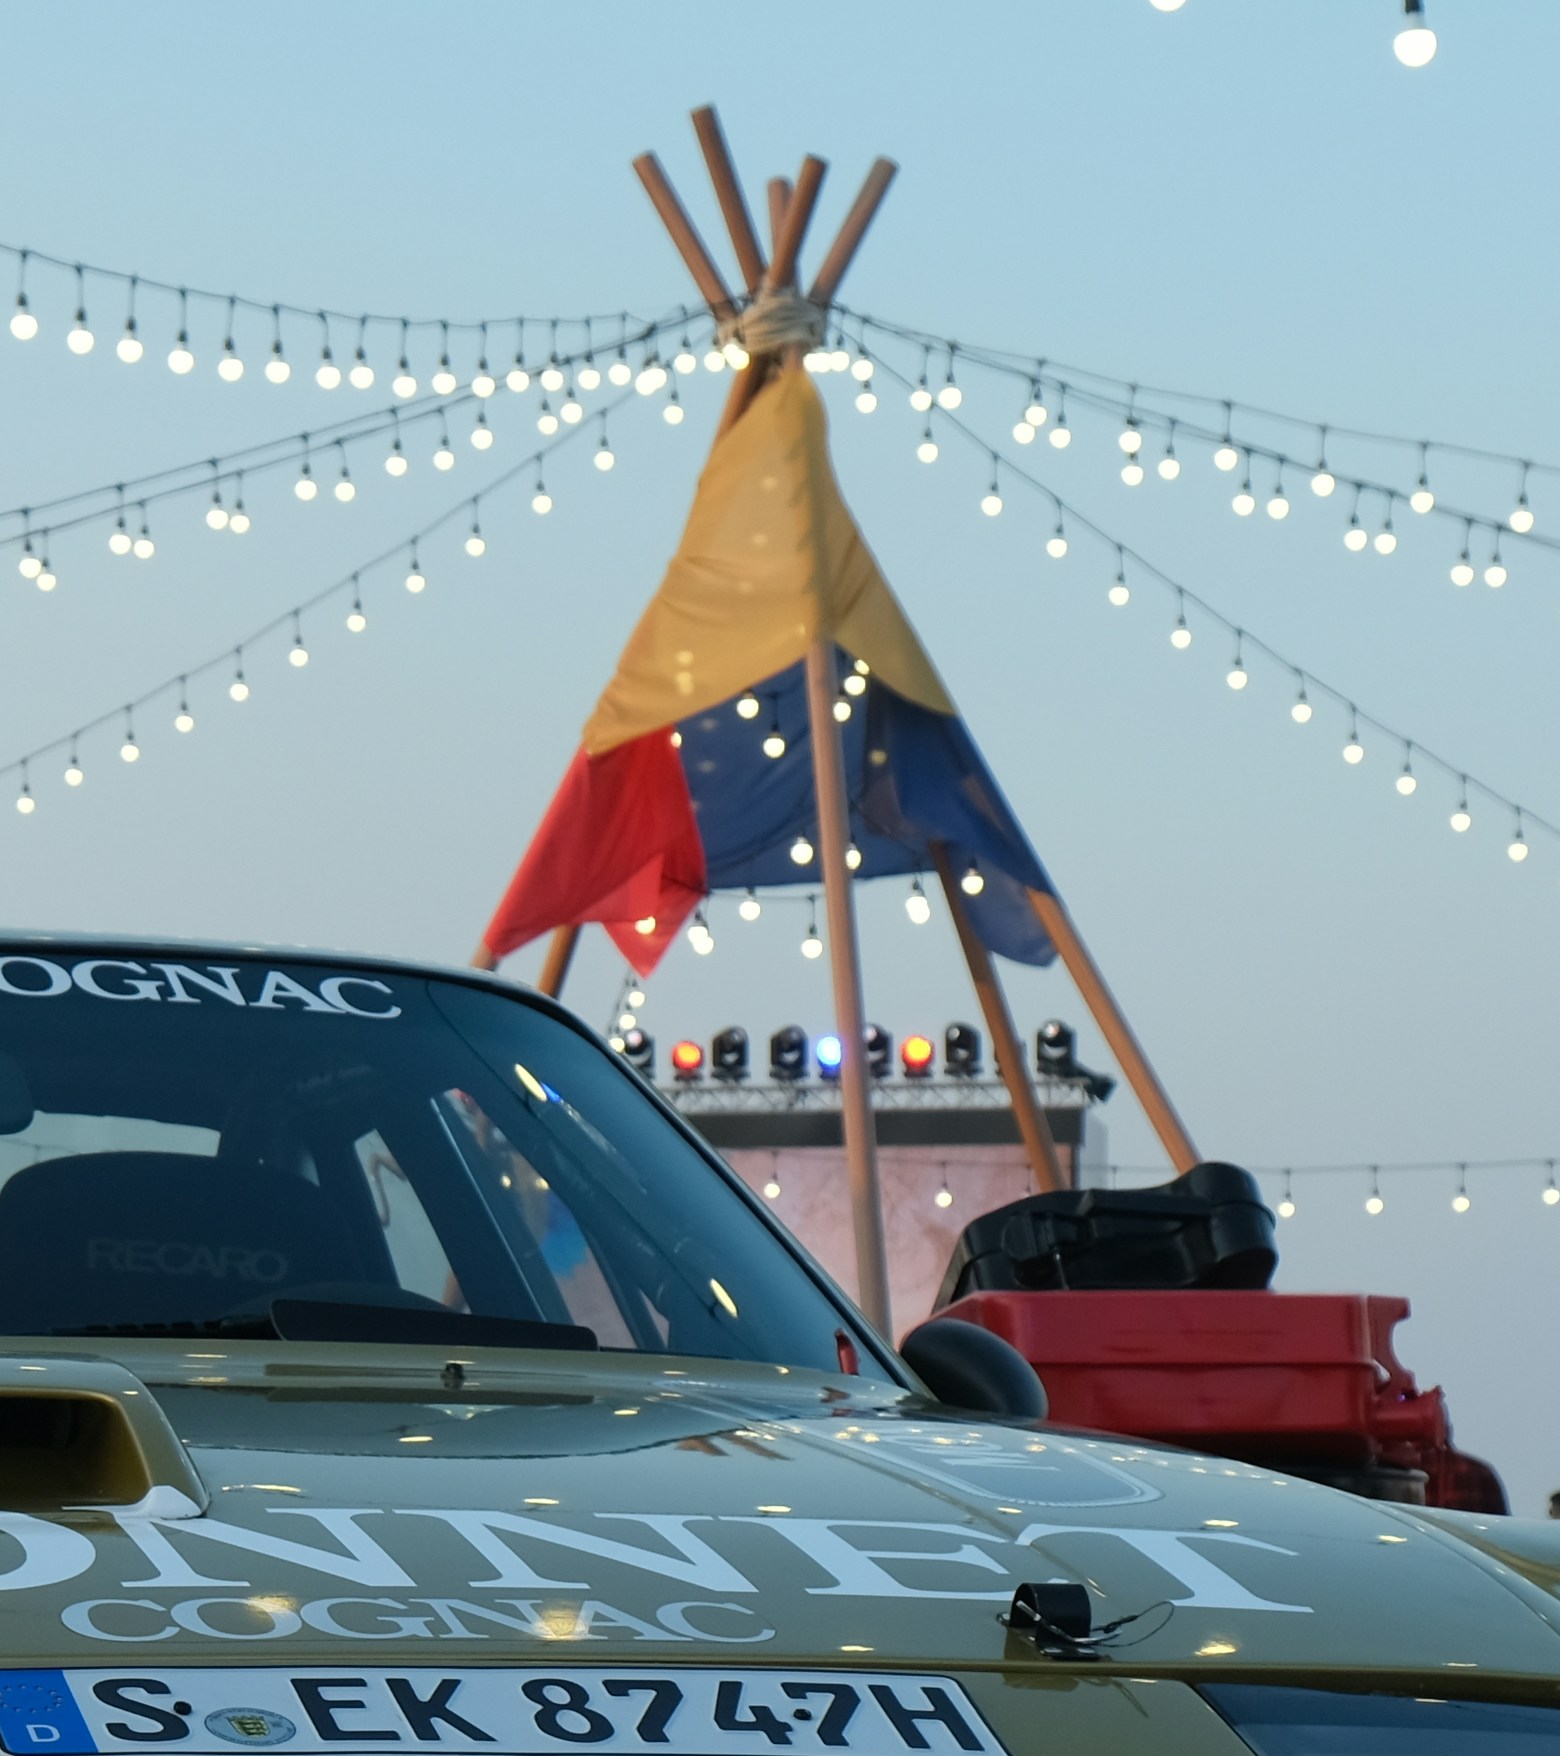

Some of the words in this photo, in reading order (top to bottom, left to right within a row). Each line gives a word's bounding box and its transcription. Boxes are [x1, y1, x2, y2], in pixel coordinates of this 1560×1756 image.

[86, 1238, 288, 1283] RECARO
[60, 1597, 777, 1644] COGNAC
[26, 1723, 61, 1743] D
[92, 1677, 191, 1743] S
[290, 1677, 498, 1743] EK
